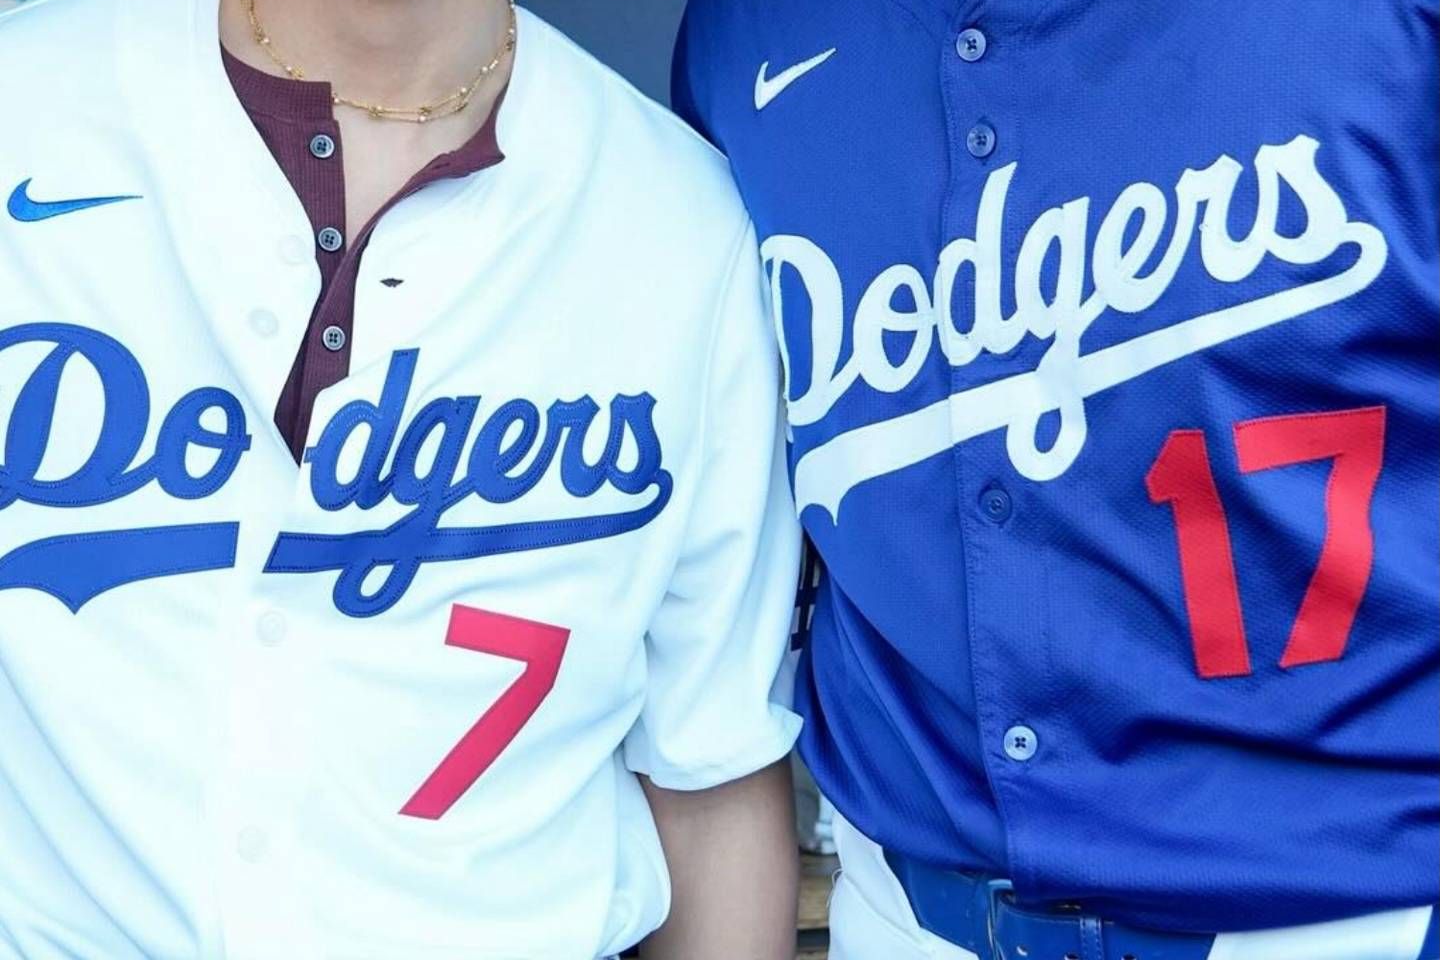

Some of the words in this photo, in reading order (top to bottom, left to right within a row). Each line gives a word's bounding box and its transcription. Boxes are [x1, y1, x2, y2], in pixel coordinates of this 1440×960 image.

[760, 134, 1387, 482] Dodgers
[0, 322, 673, 617] Dodgers
[1145, 405, 1387, 679] 17
[397, 603, 571, 821] 7
